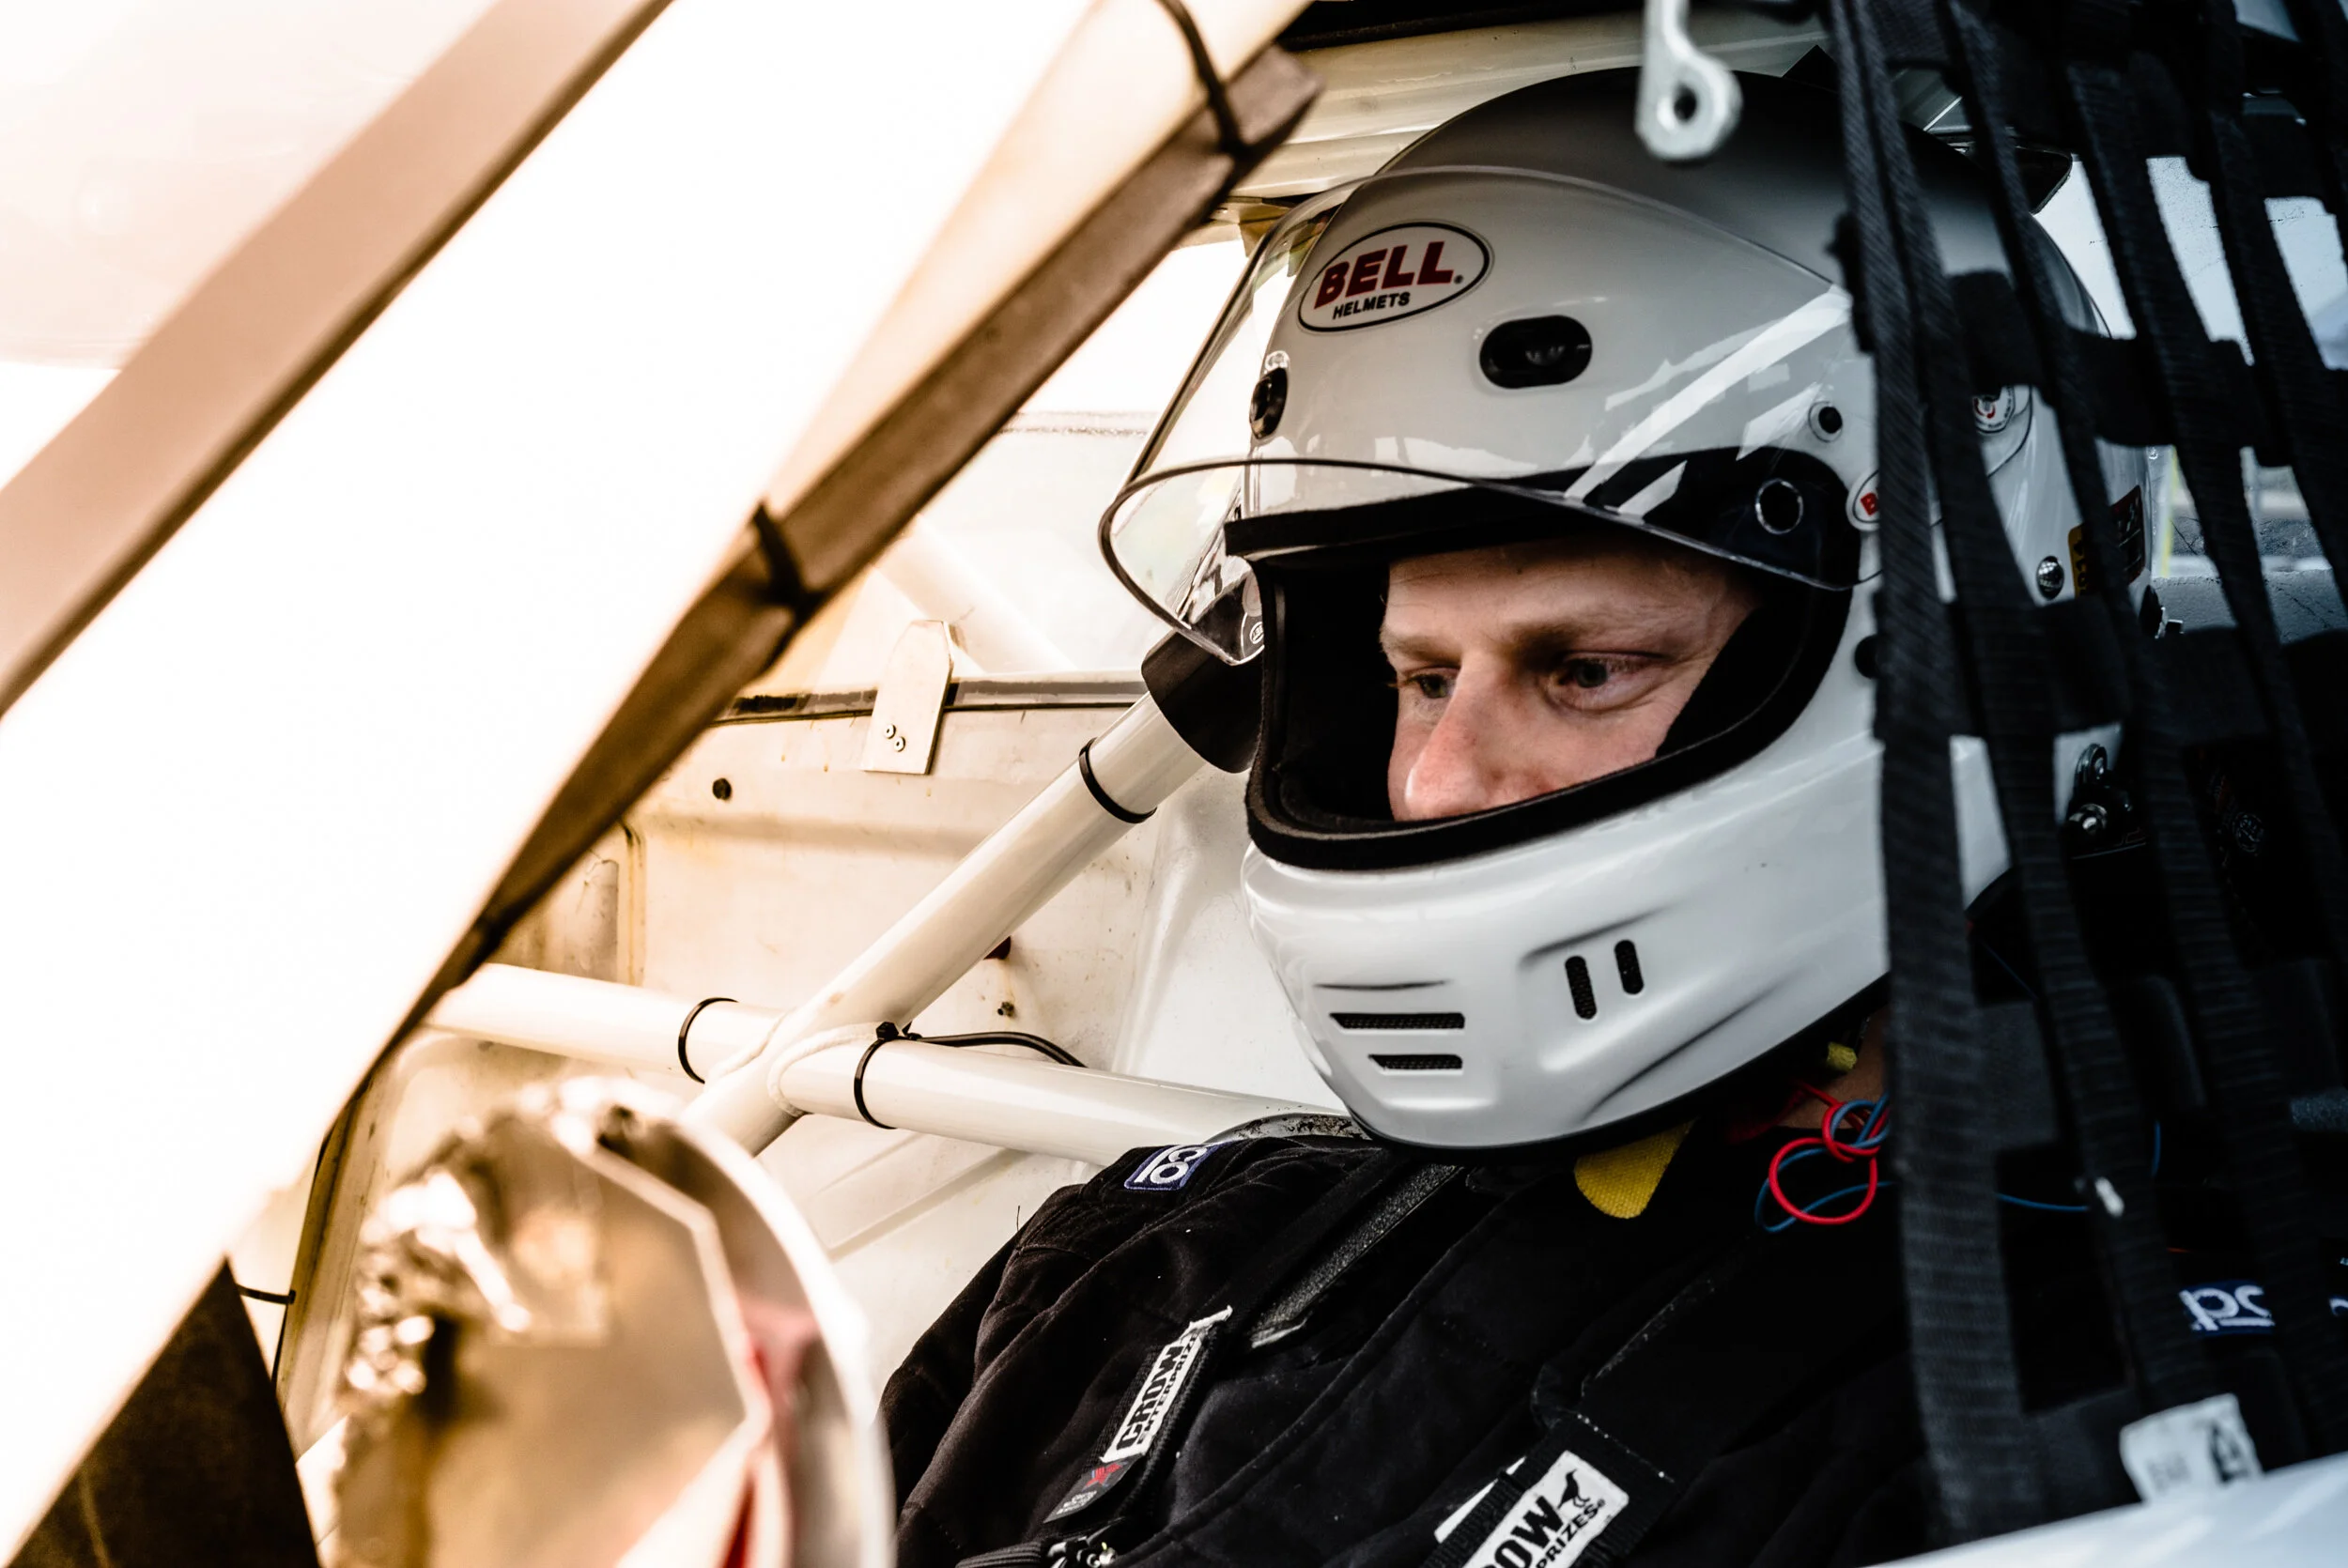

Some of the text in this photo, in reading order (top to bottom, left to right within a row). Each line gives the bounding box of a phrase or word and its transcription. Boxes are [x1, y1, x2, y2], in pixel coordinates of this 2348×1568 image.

[1314, 241, 1455, 310] BELL
[1333, 291, 1411, 319] HELMETS
[1117, 1345, 1184, 1451] CROW
[1480, 1496, 1564, 1568] OW
